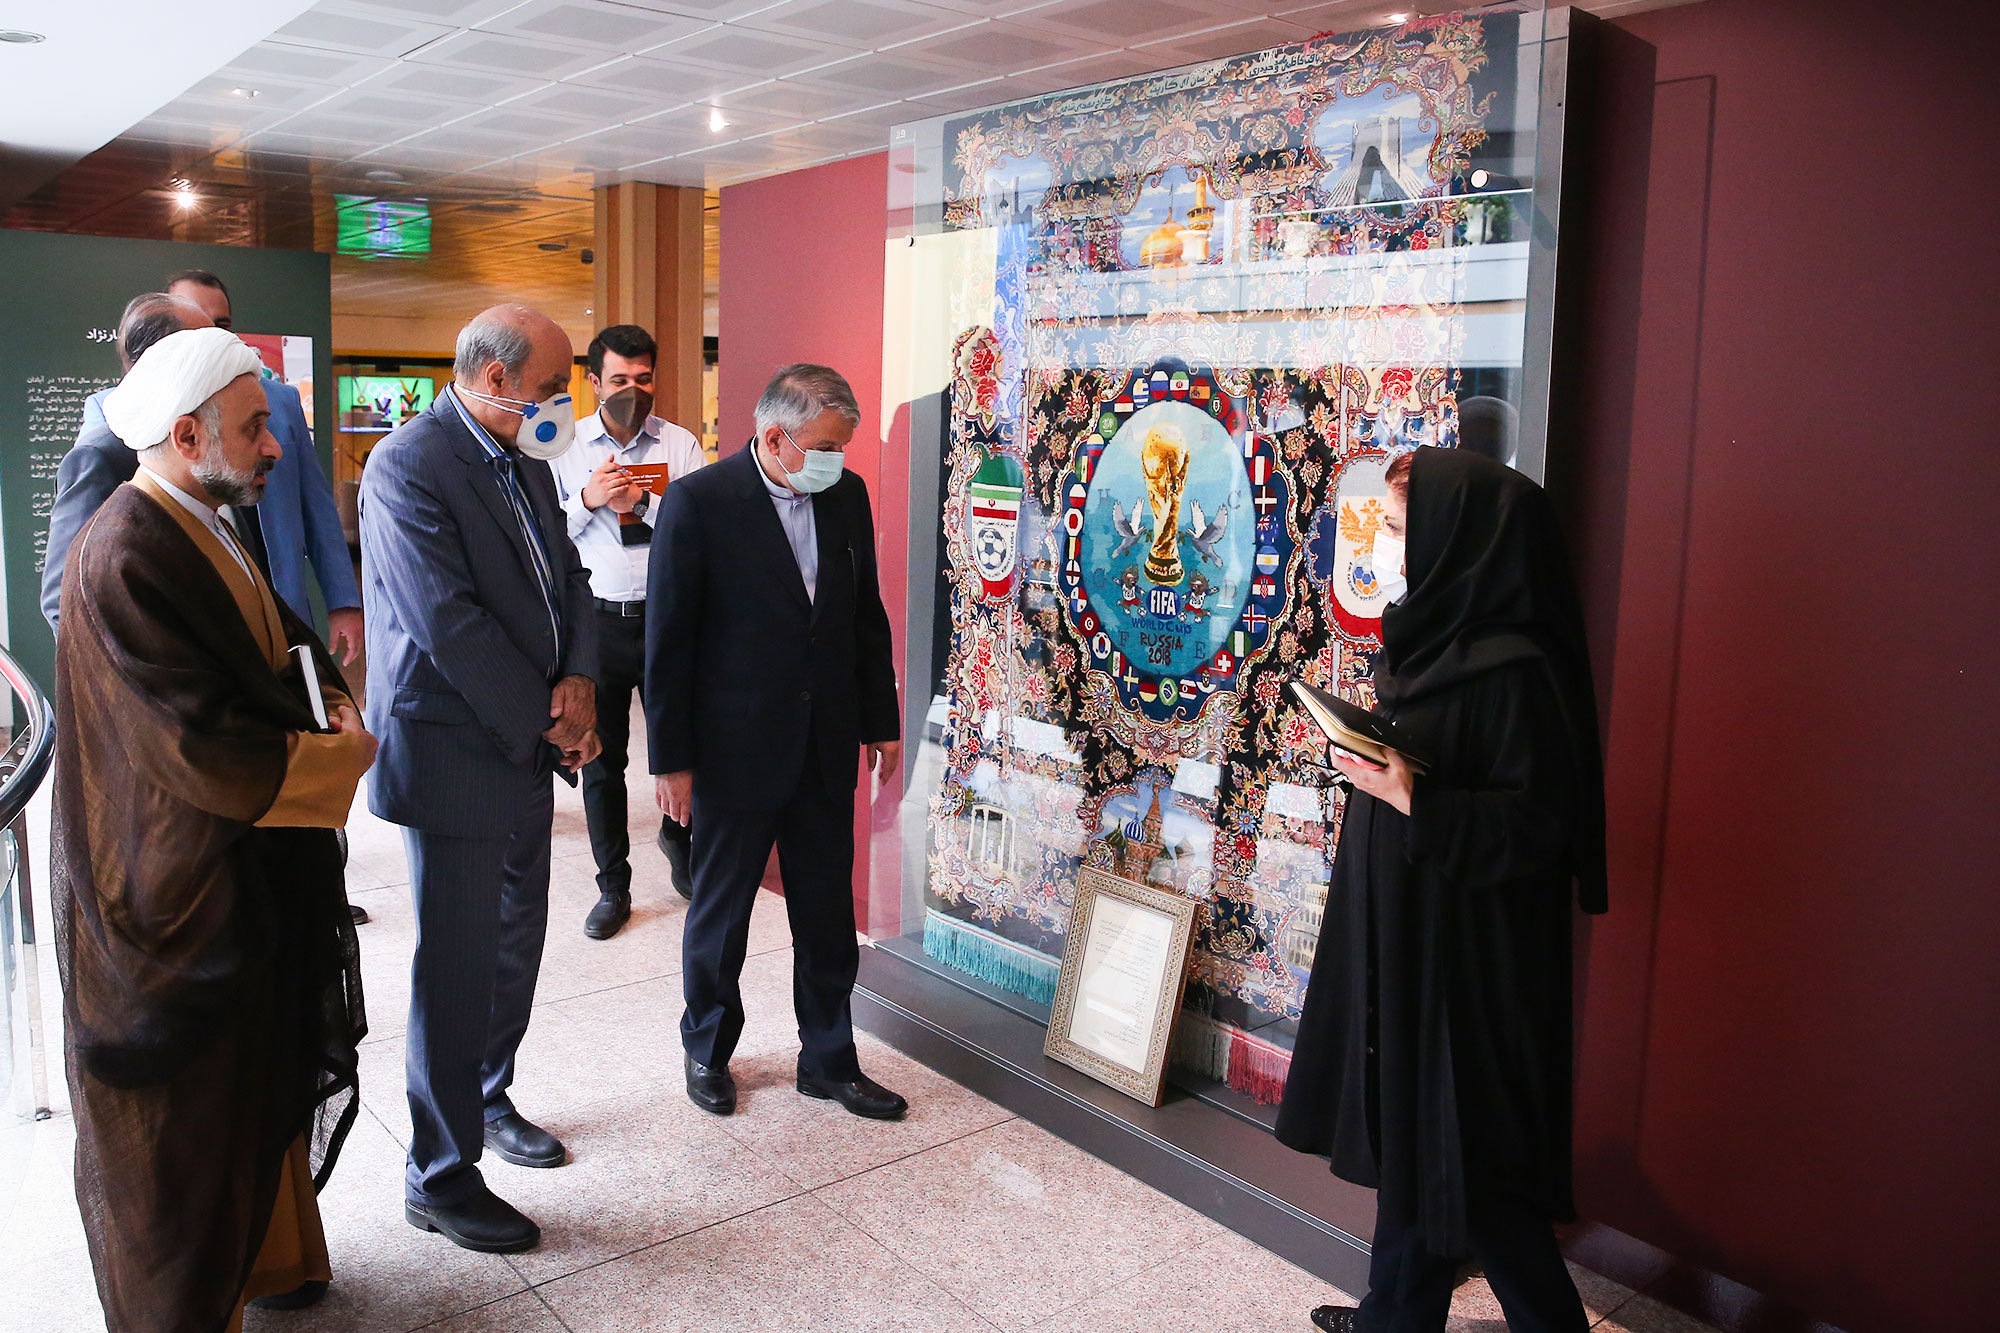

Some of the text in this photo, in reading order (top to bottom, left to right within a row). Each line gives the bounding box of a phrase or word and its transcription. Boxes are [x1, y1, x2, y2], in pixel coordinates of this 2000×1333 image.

[86, 328, 118, 342] ارنژاد
[1150, 589, 1176, 615] FIFA
[1140, 631, 1184, 651] RUSSIA
[1148, 647, 1171, 666] 2018
